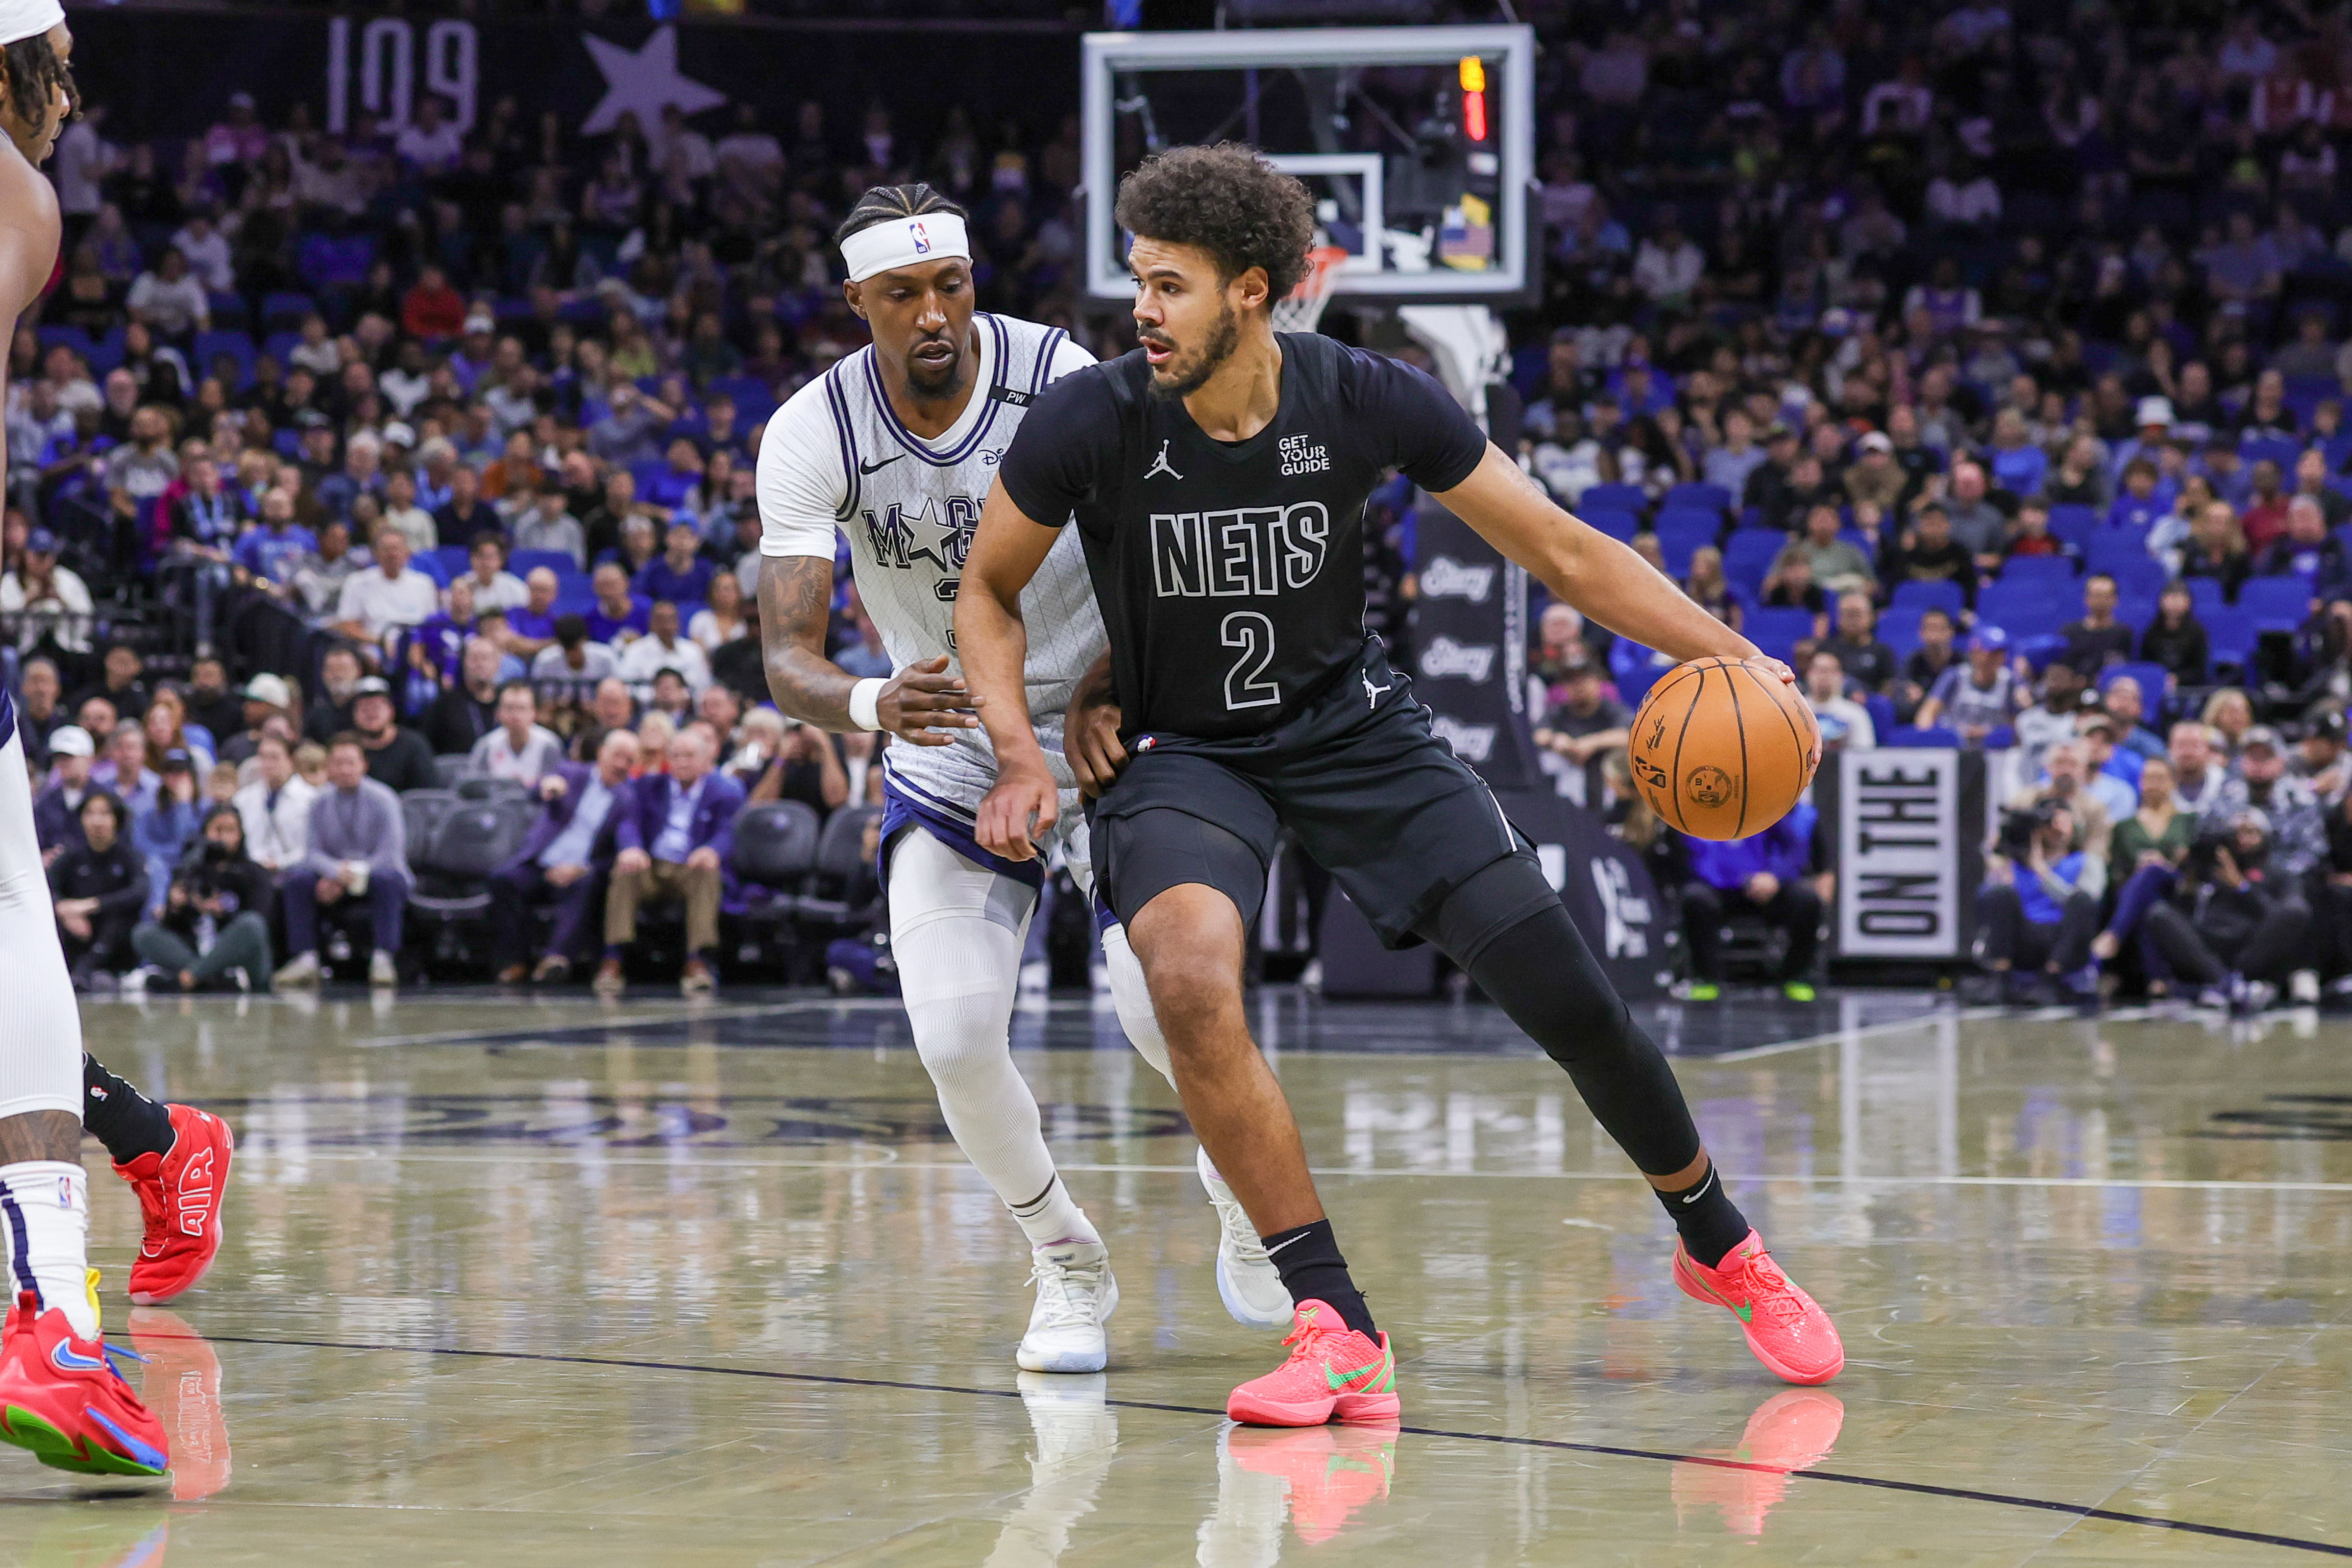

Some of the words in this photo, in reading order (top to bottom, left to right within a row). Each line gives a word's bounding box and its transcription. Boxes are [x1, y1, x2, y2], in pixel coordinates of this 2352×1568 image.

[326, 17, 478, 133] 109
[1006, 392, 1026, 404] PW
[1278, 434, 1308, 450] GET
[1279, 445, 1326, 463] YOUR
[1281, 458, 1330, 476] GUIDE
[1150, 501, 1329, 597] NETS
[1220, 611, 1281, 710] 2
[1859, 767, 1939, 857] THE
[1859, 873, 1939, 935] ON
[178, 1146, 214, 1237] AIR
